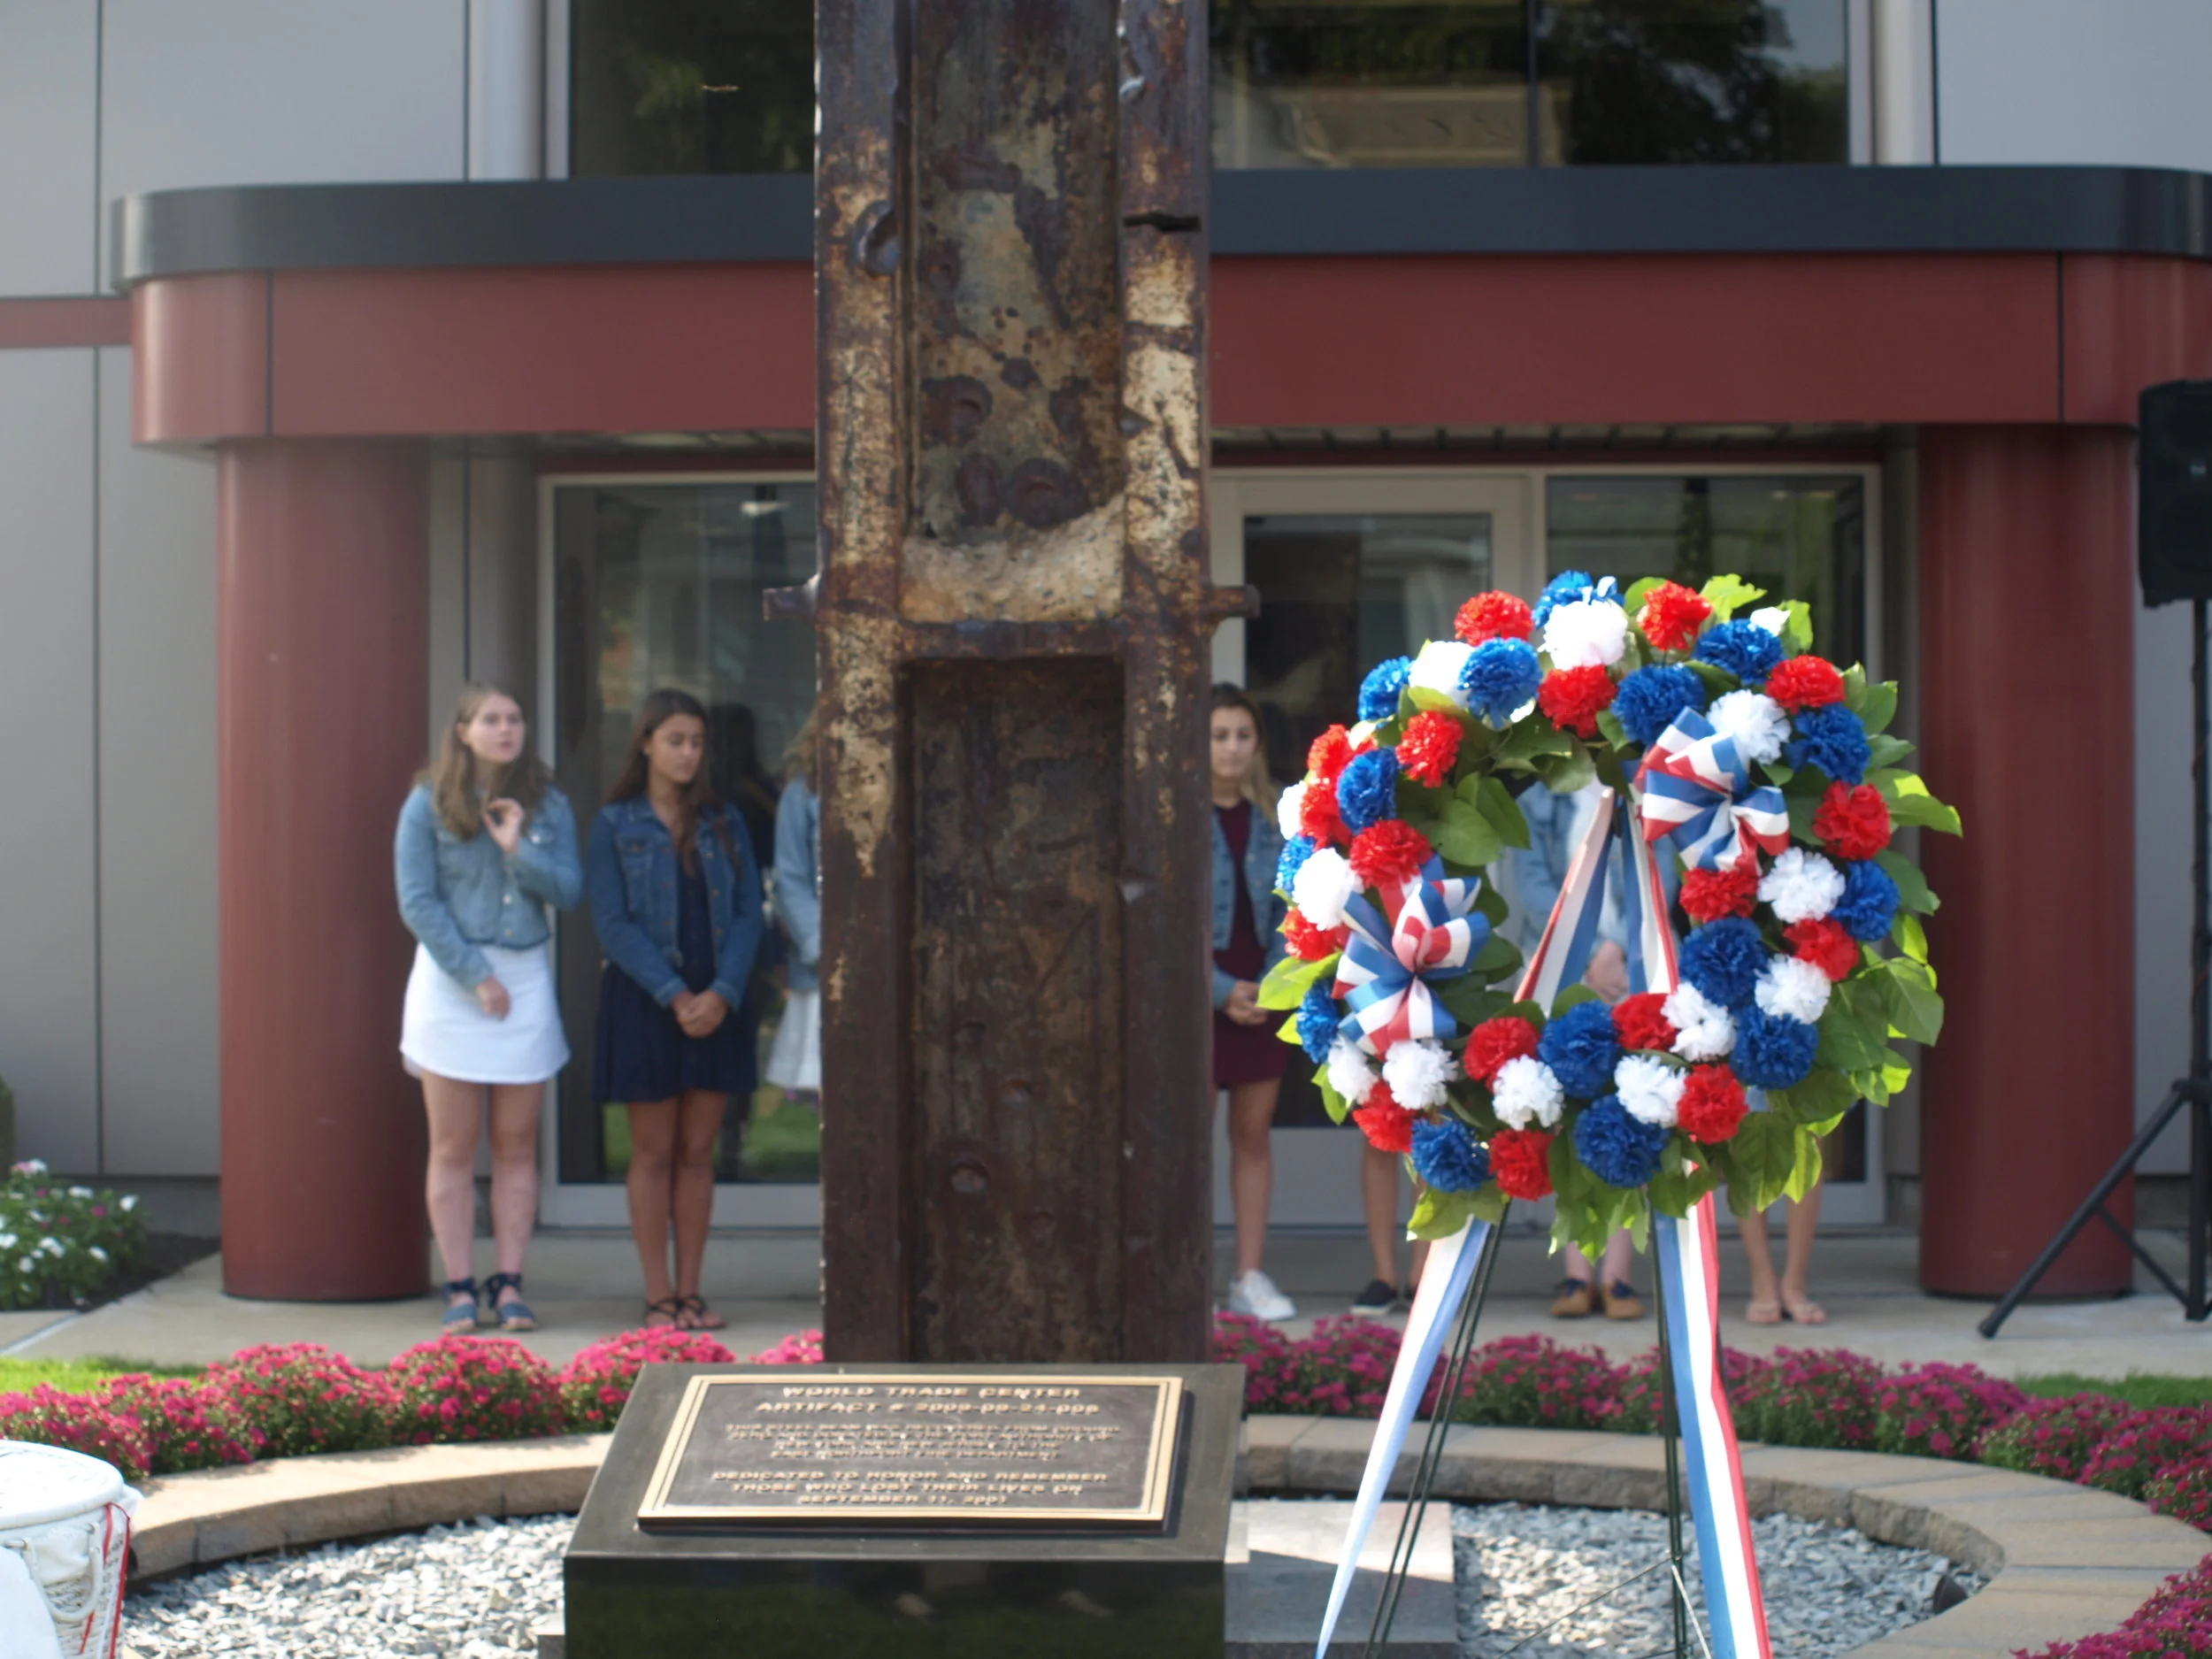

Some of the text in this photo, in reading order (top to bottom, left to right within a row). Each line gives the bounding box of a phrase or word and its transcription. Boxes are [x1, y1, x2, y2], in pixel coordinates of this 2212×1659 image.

[783, 1386, 1080, 1398] WORLD TRADE CENTER
[757, 1402, 880, 1413] ARTIFACT
[711, 1471, 1108, 1482] DEDICATED TO HONOR AND REMEMBER
[732, 1483, 1084, 1494] THOSE WHO LOST THEIR LIVES ON
[796, 1494, 918, 1504] SEPTEMBER
